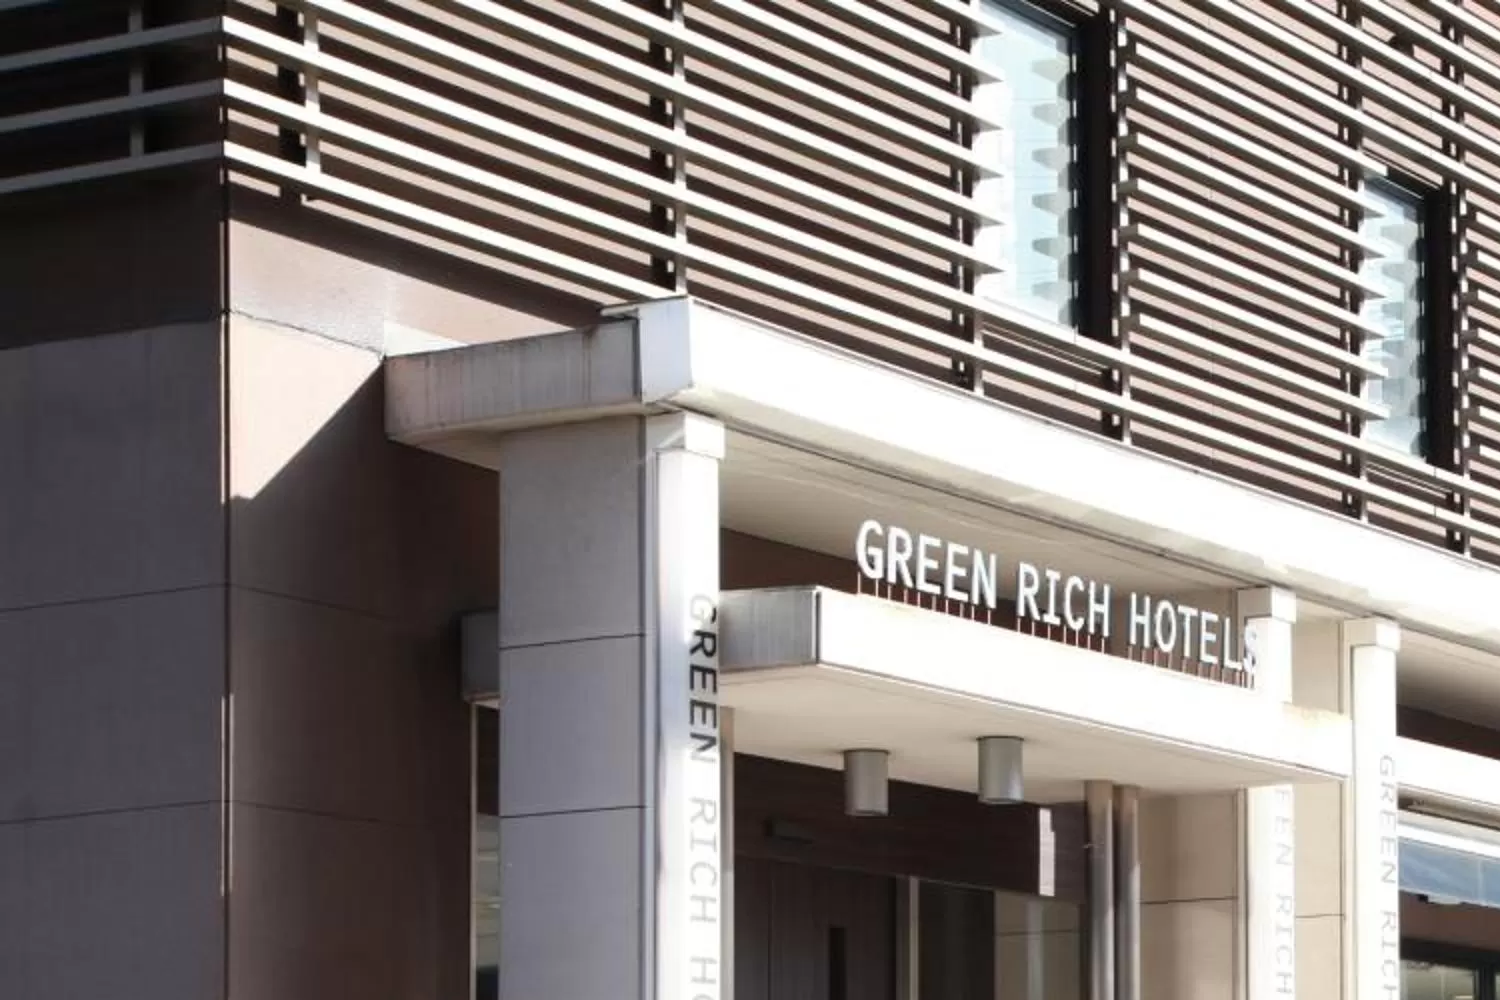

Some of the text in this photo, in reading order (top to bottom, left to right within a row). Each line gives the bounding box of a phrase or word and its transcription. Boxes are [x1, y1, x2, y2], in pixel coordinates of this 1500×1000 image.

[856, 518, 1259, 674] GREEN RICH HOTELS
[688, 593, 718, 763] GREEN
[688, 796, 718, 924] RICH
[1378, 754, 1399, 884] GREEN
[1275, 893, 1294, 994] RICH
